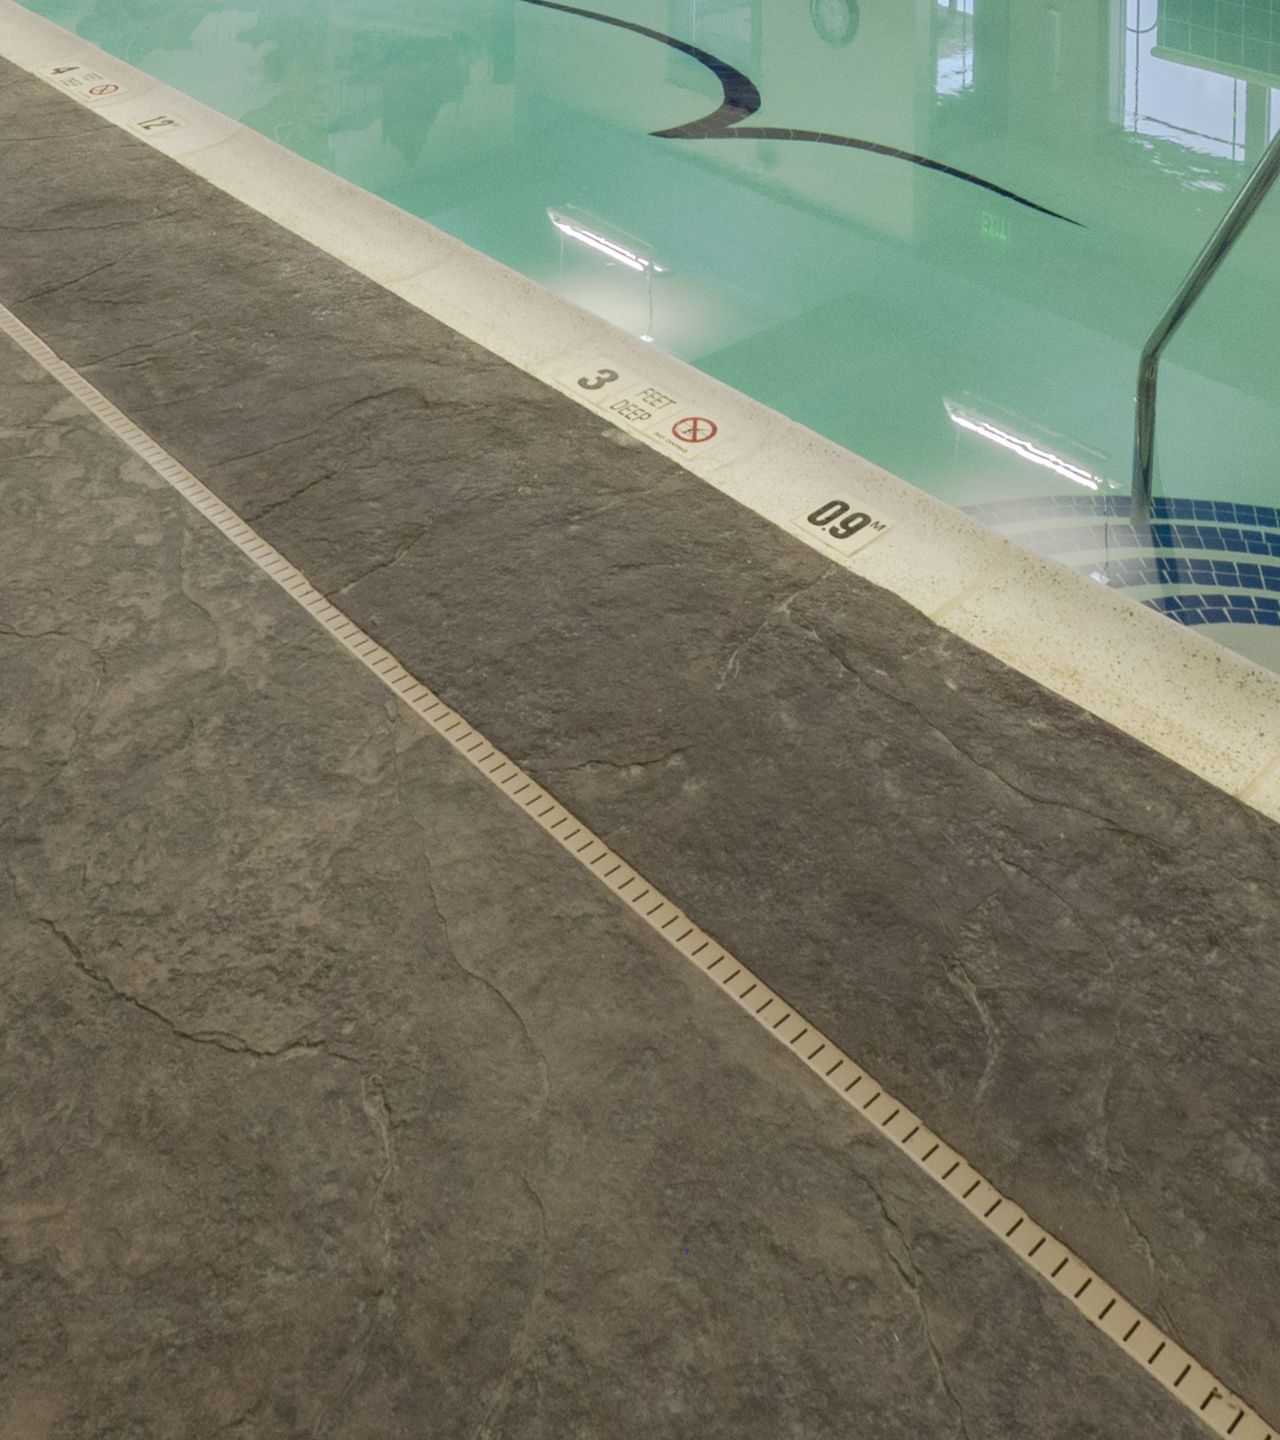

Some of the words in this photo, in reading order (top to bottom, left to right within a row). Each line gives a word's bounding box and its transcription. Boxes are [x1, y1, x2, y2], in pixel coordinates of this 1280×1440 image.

[577, 368, 620, 391] 3
[635, 387, 677, 410] FEET
[609, 399, 652, 422] DEEP
